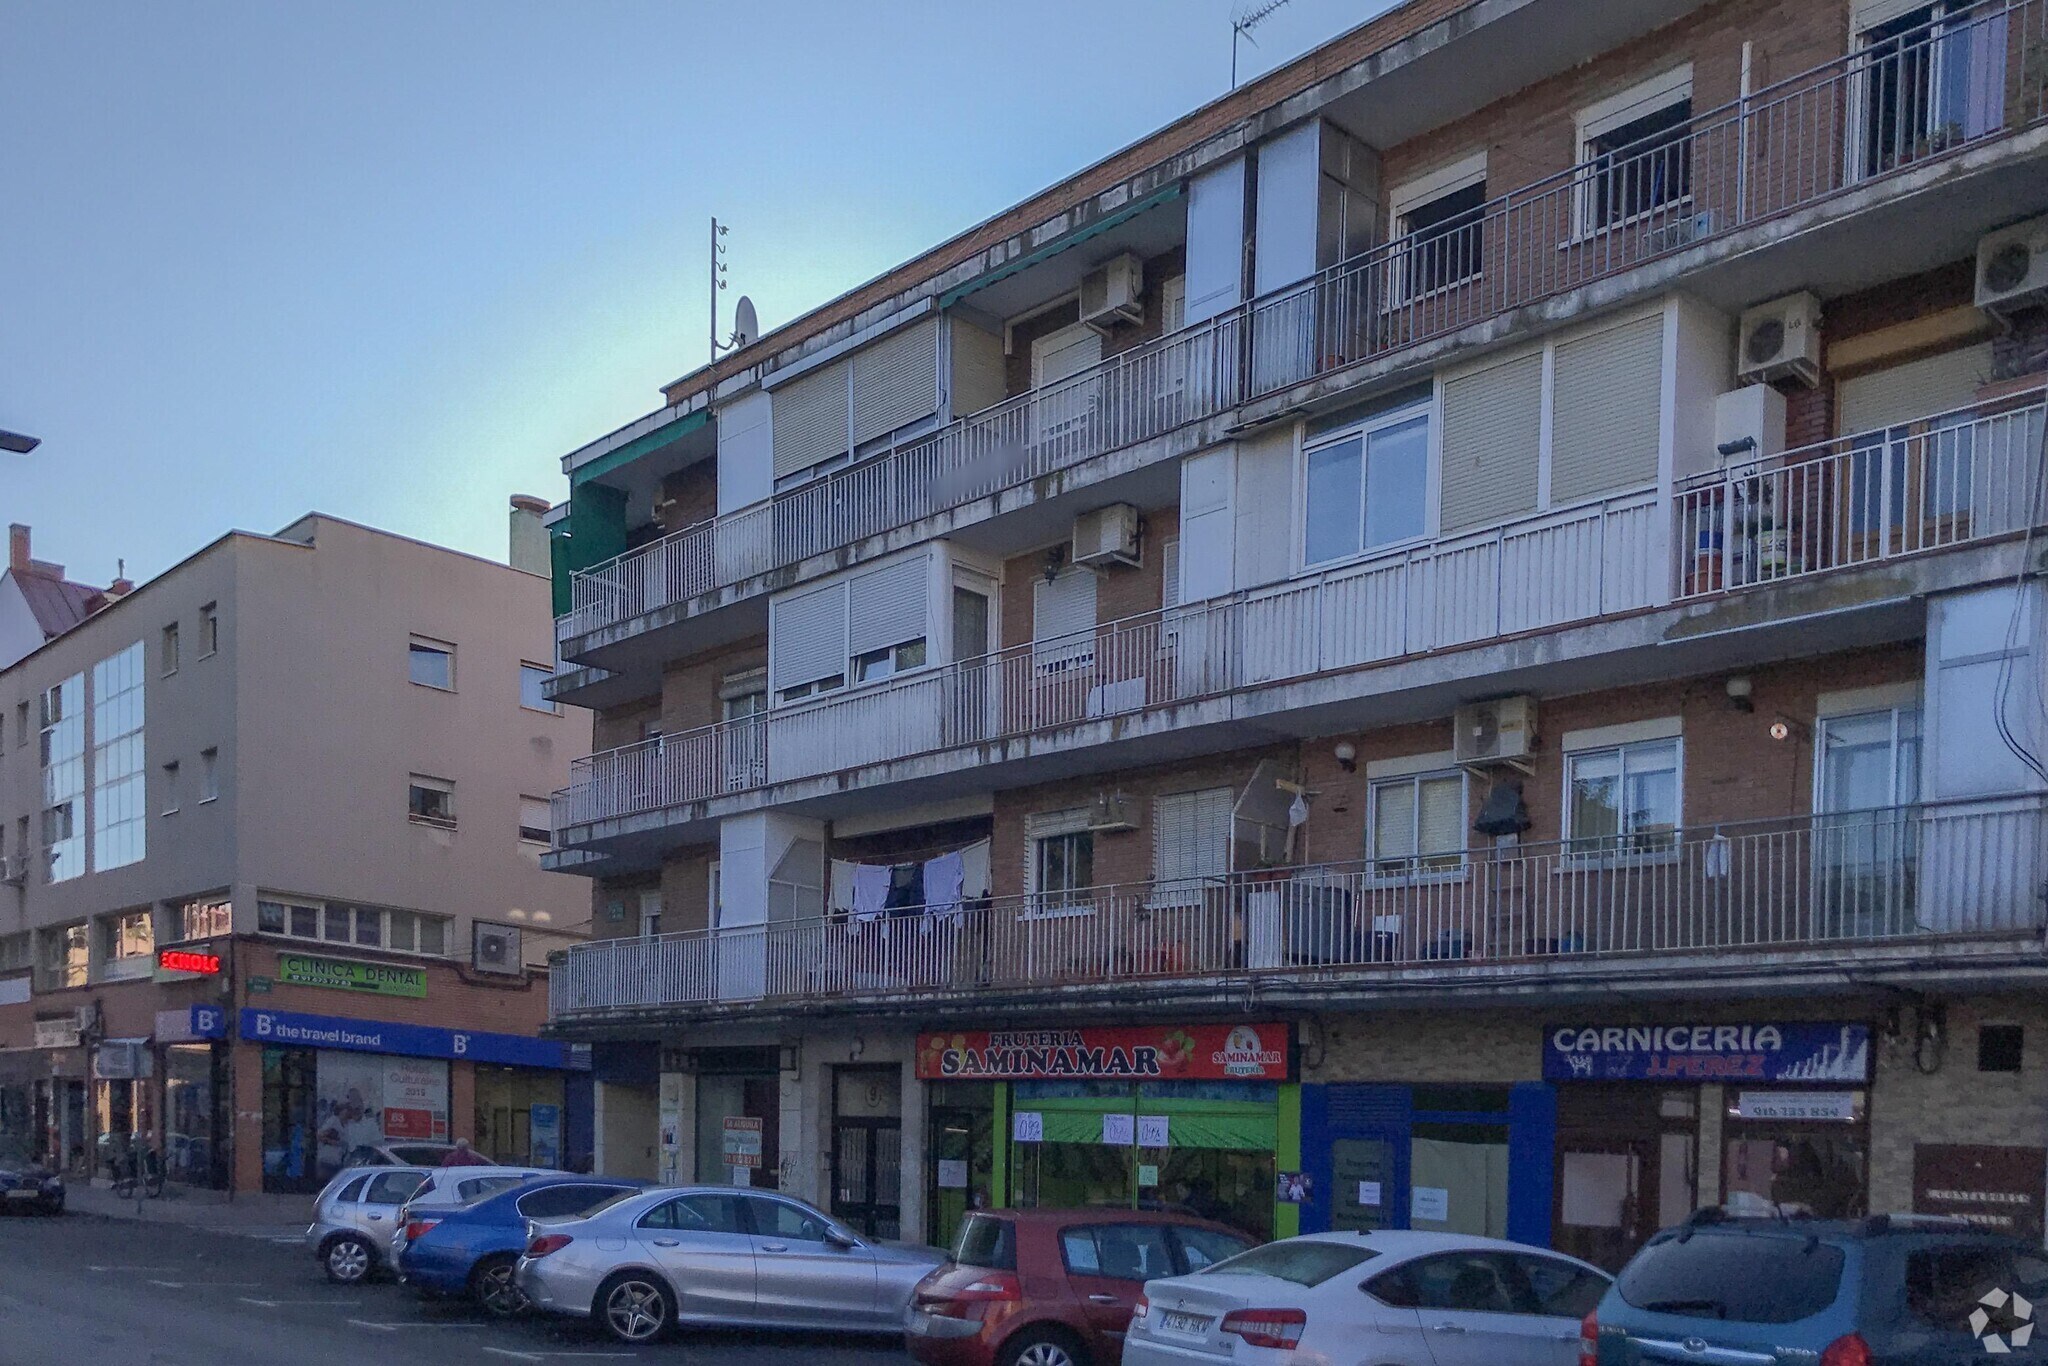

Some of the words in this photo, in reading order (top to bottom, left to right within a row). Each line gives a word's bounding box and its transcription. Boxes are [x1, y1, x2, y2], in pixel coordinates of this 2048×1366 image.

[365, 967, 422, 986] DENTAL
[276, 1024, 299, 1038] the
[301, 1027, 340, 1042] travel
[341, 1030, 381, 1046] brand
[989, 1030, 1086, 1048] FRUTERIA
[1553, 1025, 1782, 1051] CARNICERIA
[941, 1045, 1161, 1077] SAMINAMAR
[1212, 1050, 1282, 1064] SAMINAMAR
[1646, 1054, 1766, 1077] J.PEREZ
